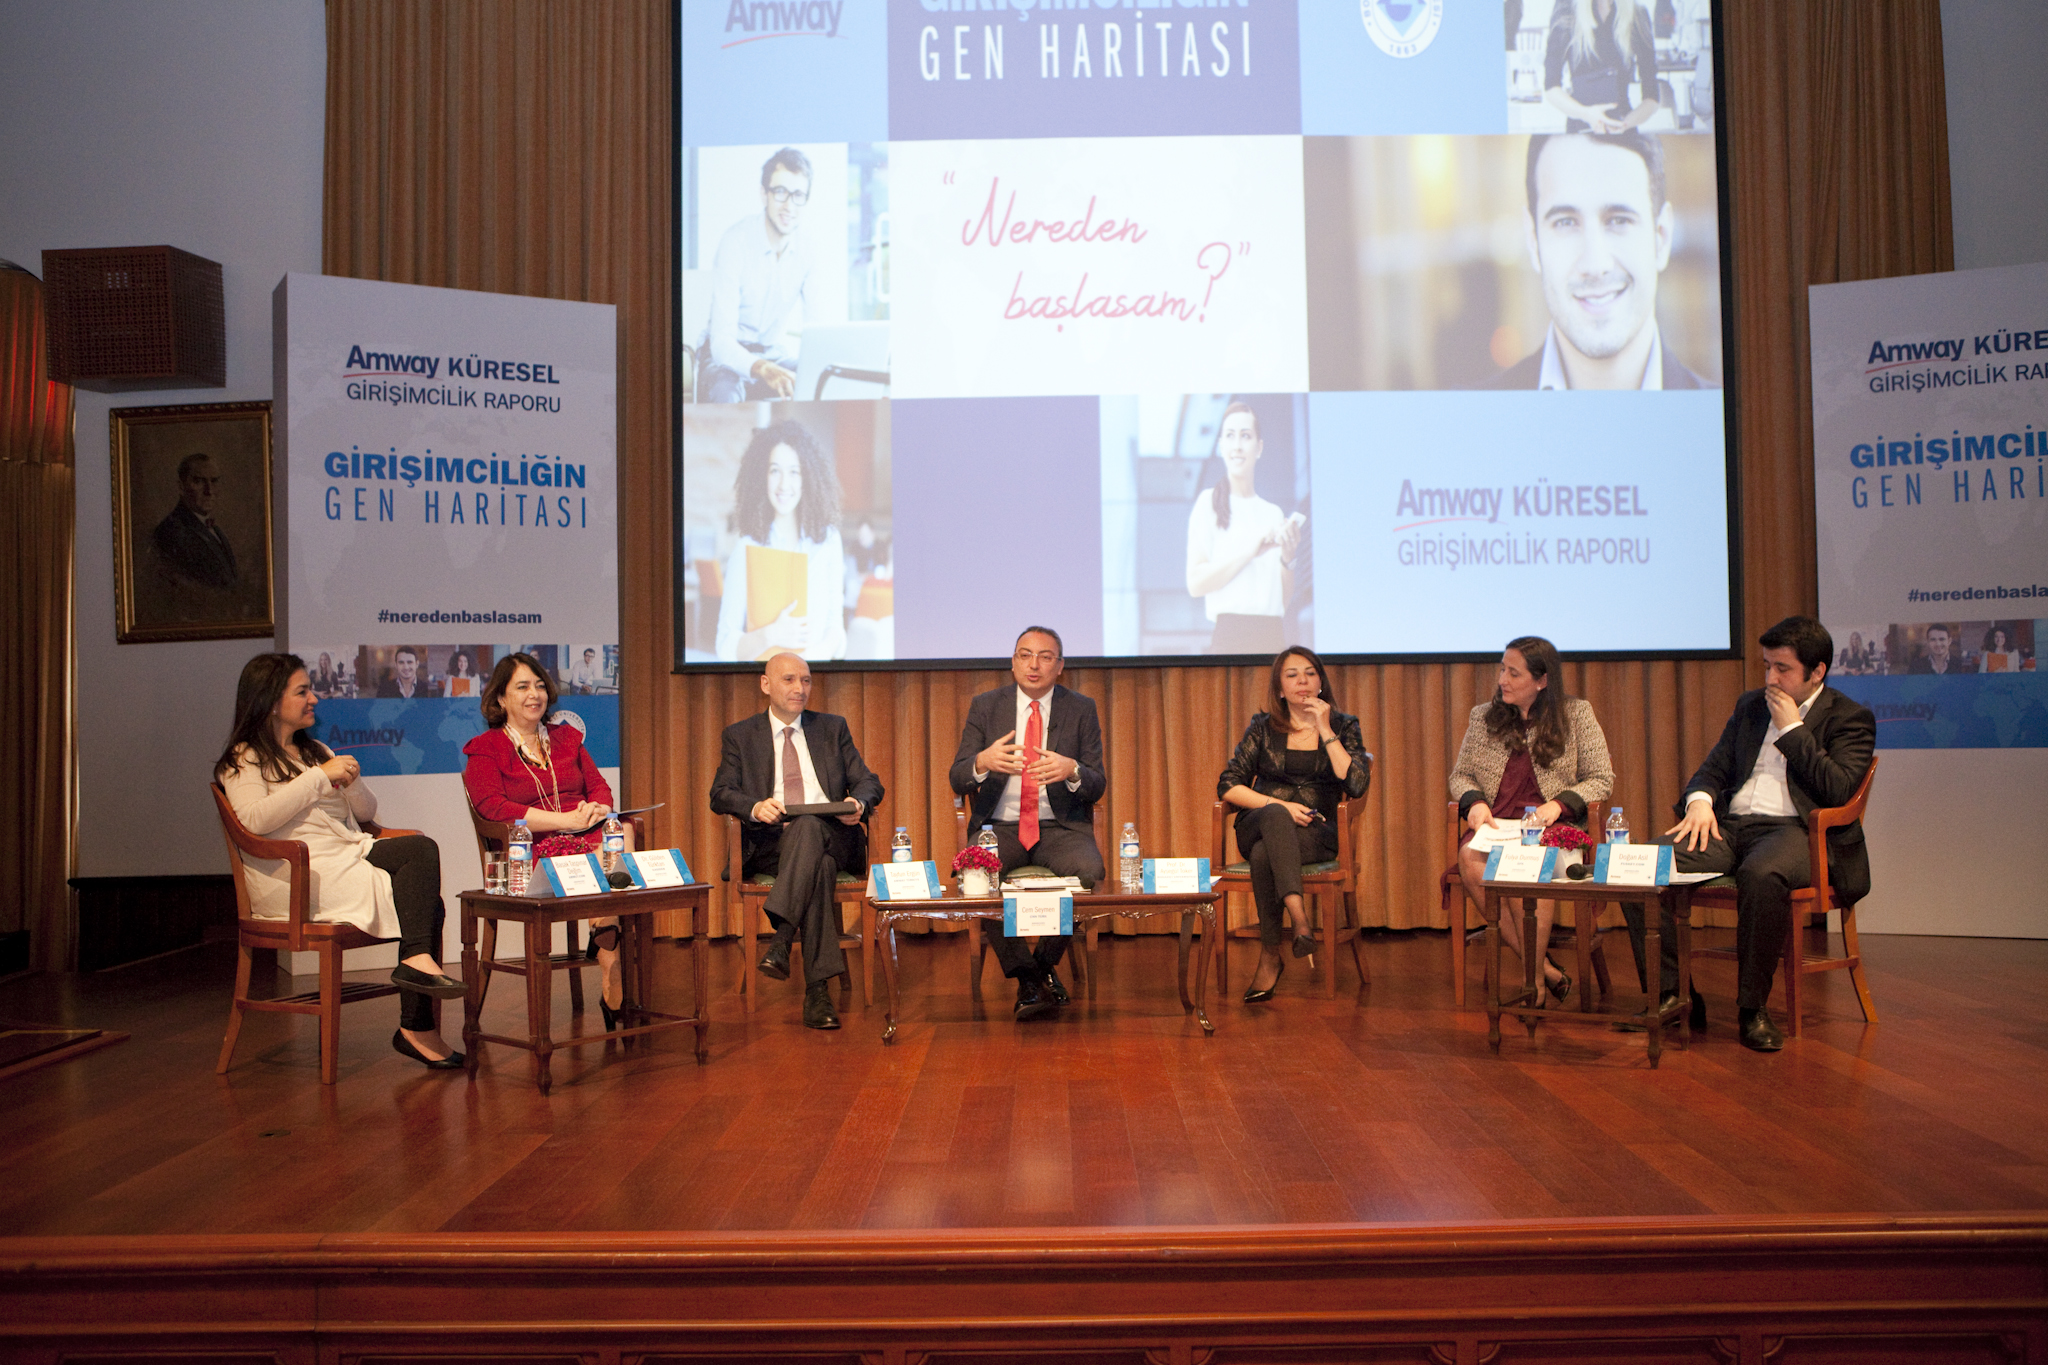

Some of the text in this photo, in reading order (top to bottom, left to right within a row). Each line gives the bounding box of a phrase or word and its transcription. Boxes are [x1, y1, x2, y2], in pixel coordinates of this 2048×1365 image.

[725, 0, 844, 37] Amway
[919, 10, 1251, 81] GEN HARİTASI
[345, 345, 560, 384] Amway KÜRESEL
[1868, 328, 2048, 364] Amway KÜRE
[346, 379, 561, 413] GİRİŞİMCİLİK RAPORU
[1869, 362, 2048, 393] GİRİŞİMCİLİK RA
[1850, 424, 2048, 470] GİRİŞİMCİL
[324, 445, 586, 488] GİRİŞİMCİLİĞİN
[1852, 458, 2044, 509] GEN HARİ
[325, 486, 586, 528] GEN HARİTASI
[1396, 477, 1648, 523] Amway KÜRESEL
[1398, 531, 1651, 571] GİRİŞİMCİLİK RAPORU
[1908, 584, 2048, 602] #neredenbasla
[378, 609, 542, 624] #neredenbaslasam
[327, 724, 405, 746] Amway
[1618, 853, 1637, 861] Doğan
[1034, 906, 1055, 914] Seymen
